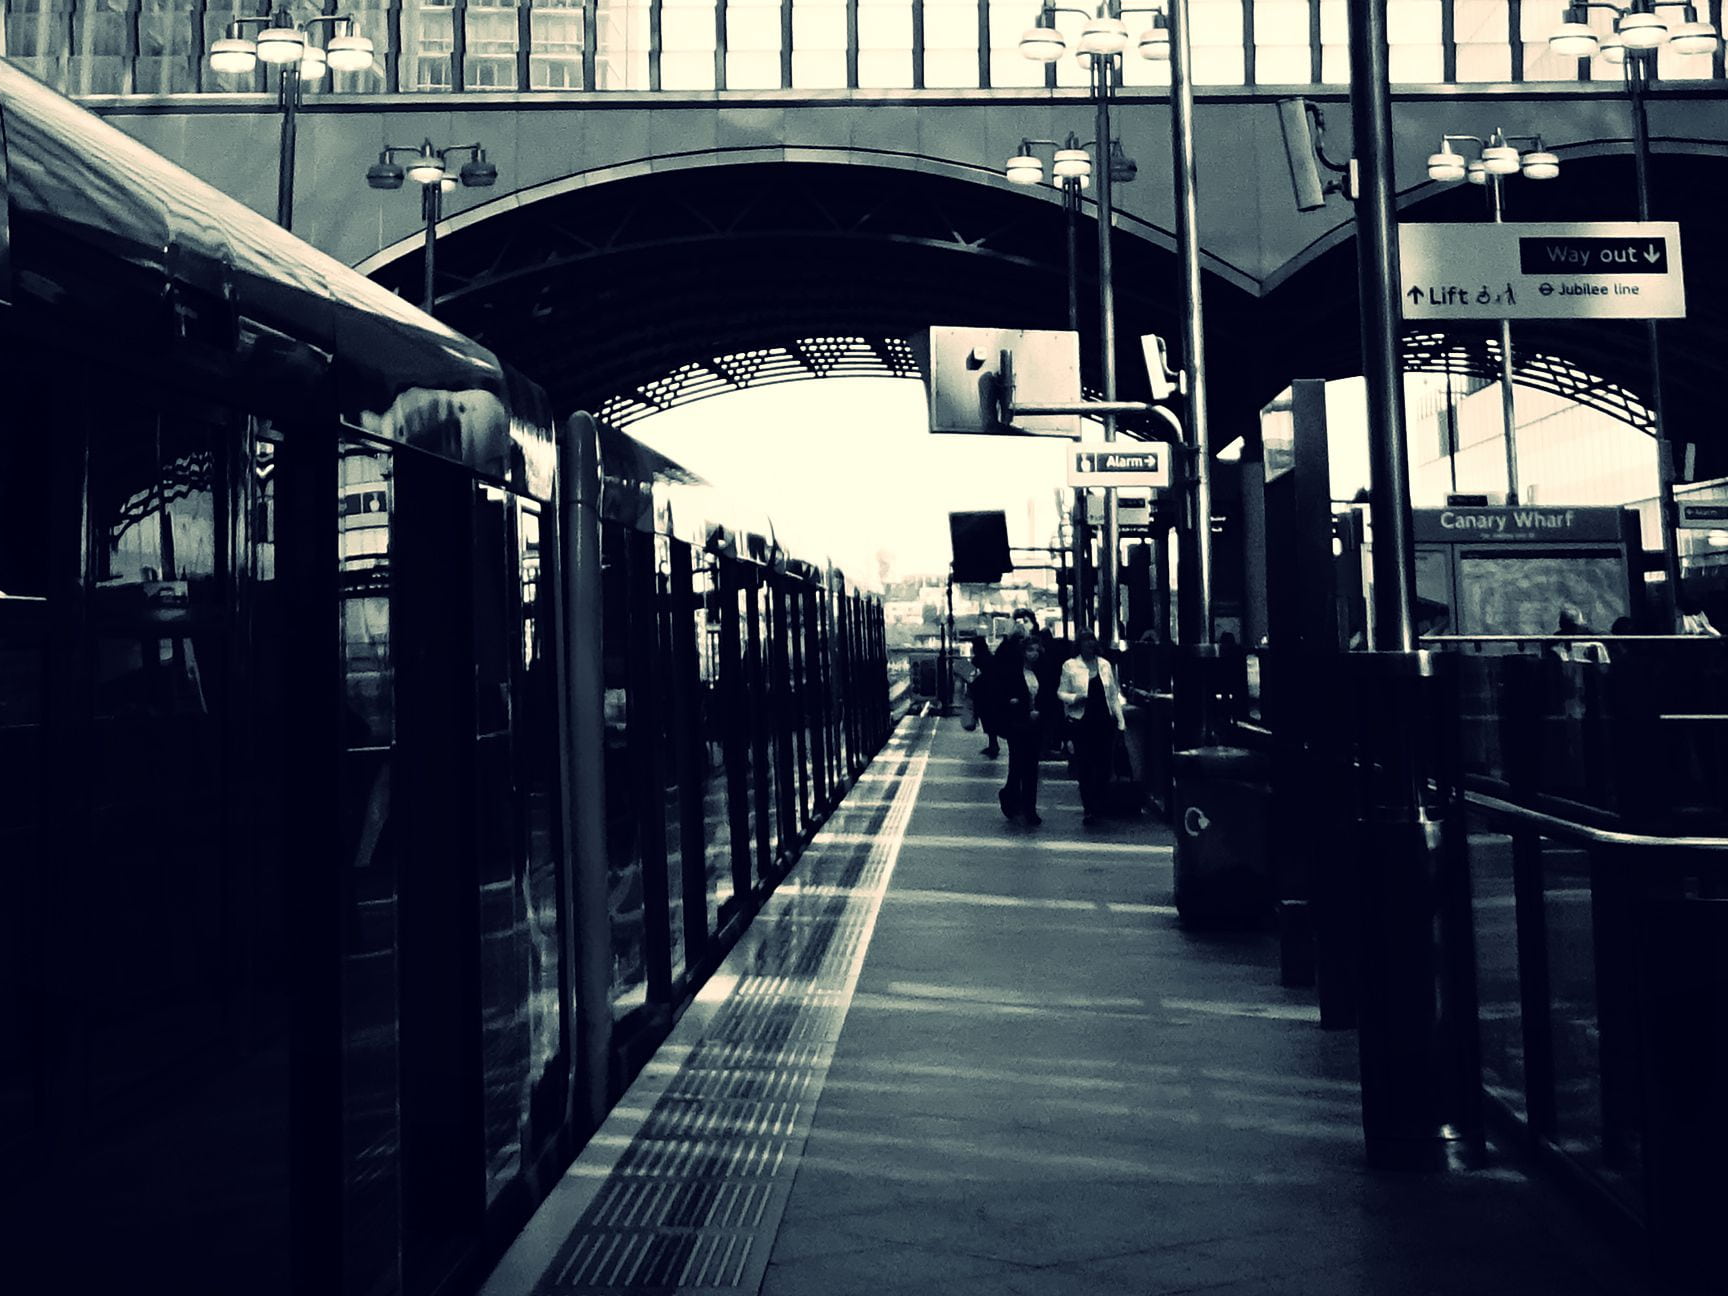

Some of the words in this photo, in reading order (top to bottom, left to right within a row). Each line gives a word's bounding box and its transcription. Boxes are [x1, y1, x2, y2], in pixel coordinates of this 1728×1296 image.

[1546, 245, 1590, 266] Way
[1600, 247, 1638, 263] out
[1429, 286, 1469, 305] Lift
[1558, 283, 1608, 296] Jubilee
[1614, 283, 1640, 295] line
[1106, 455, 1143, 468] Alarm
[1440, 511, 1506, 532] Canary
[1513, 510, 1575, 528] Wharf
